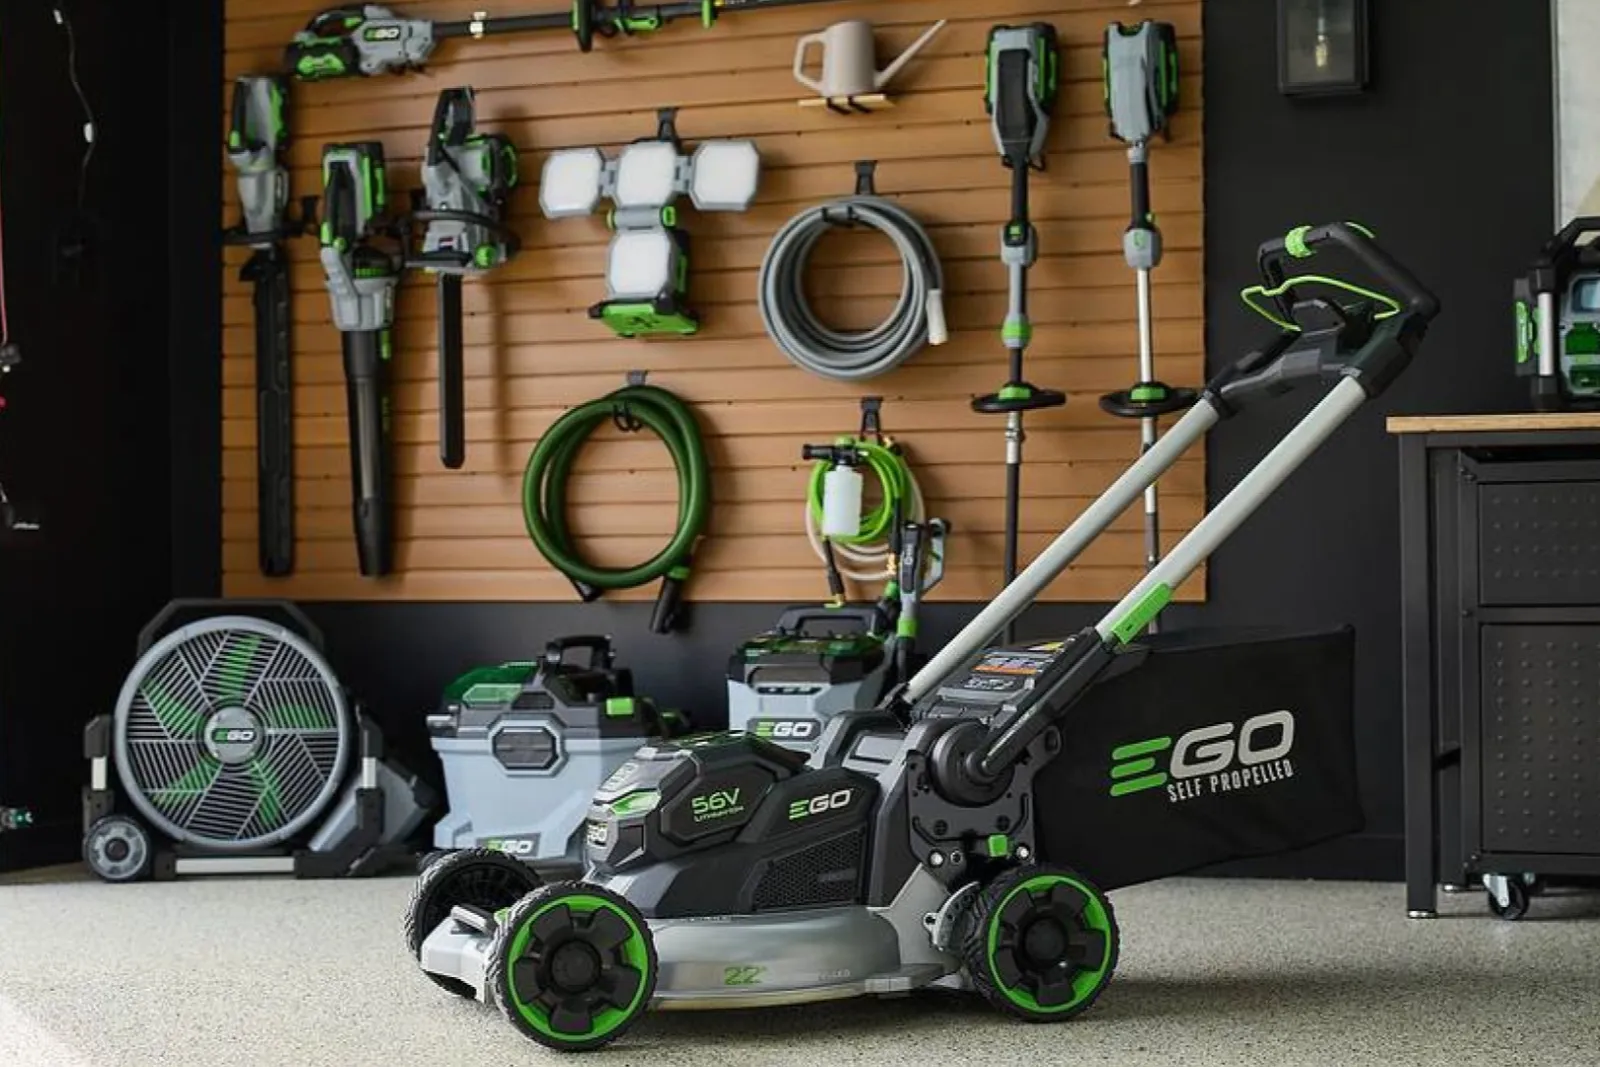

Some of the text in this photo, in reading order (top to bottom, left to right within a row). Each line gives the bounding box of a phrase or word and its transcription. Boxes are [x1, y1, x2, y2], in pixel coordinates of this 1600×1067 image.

[756, 721, 812, 737] EGO
[1110, 710, 1294, 796] EGO
[1167, 759, 1295, 802] SELF PROPELLED
[692, 788, 740, 814] 56V
[789, 789, 852, 820] EGO
